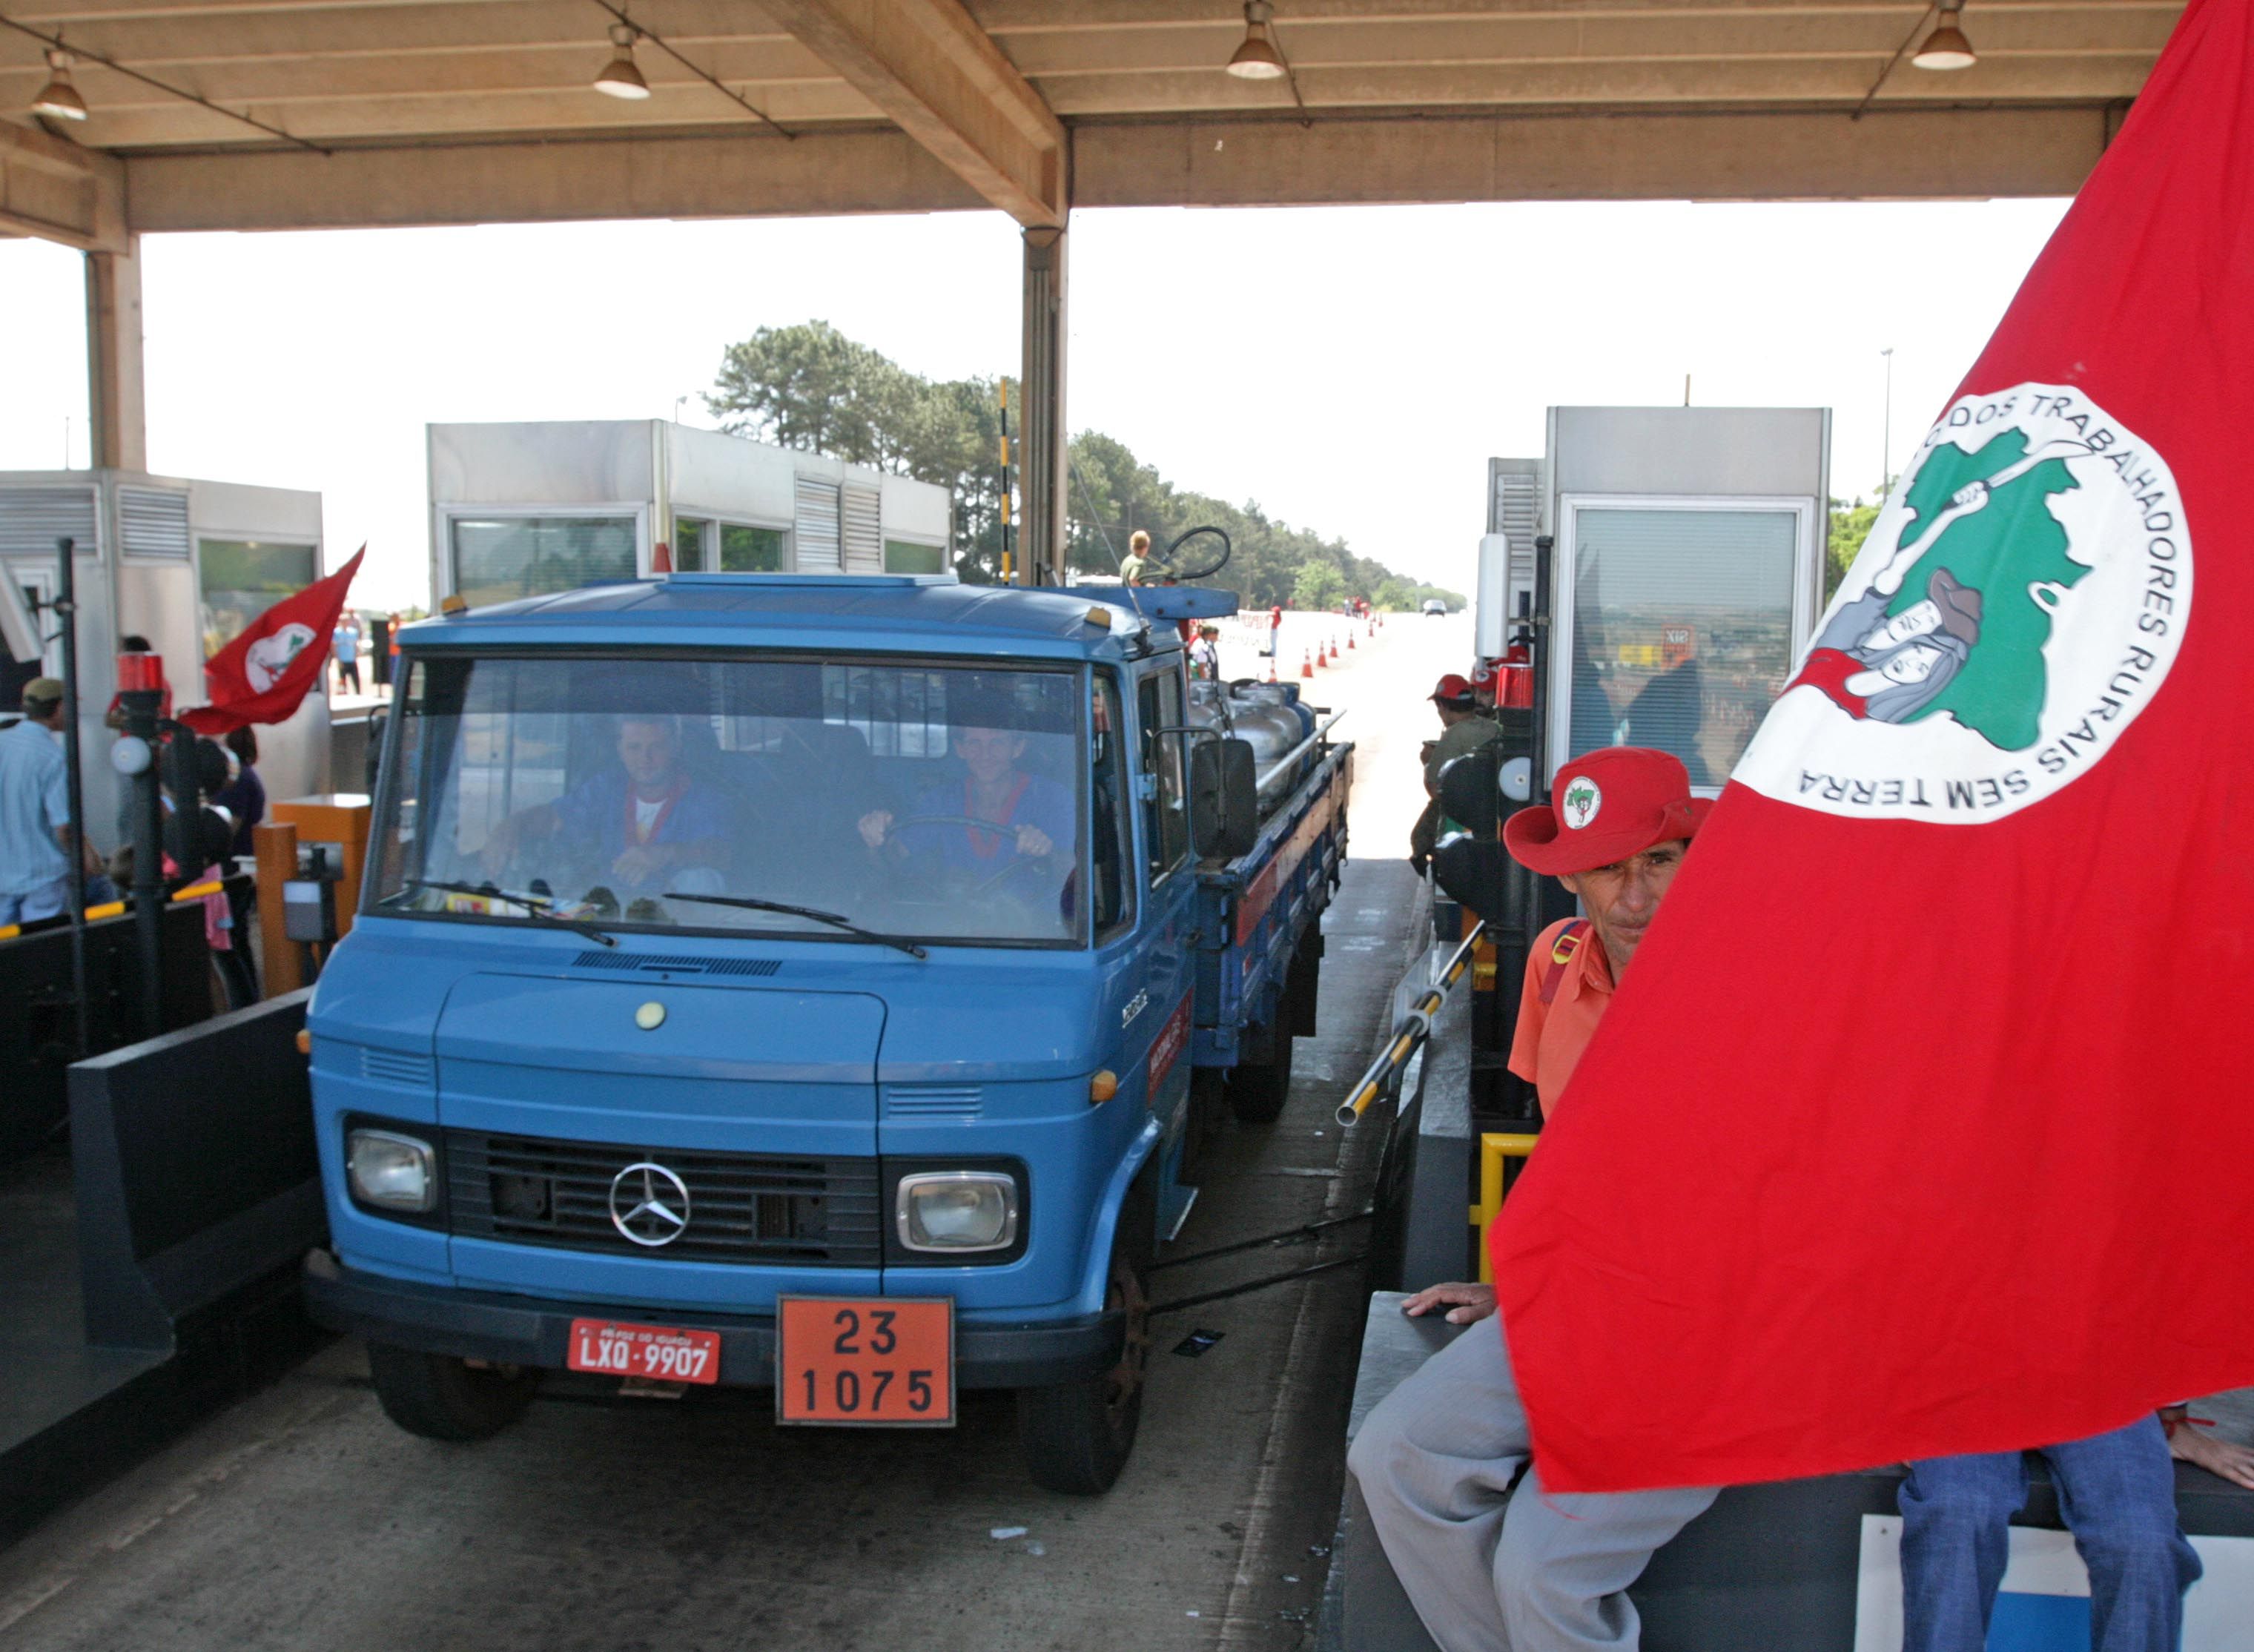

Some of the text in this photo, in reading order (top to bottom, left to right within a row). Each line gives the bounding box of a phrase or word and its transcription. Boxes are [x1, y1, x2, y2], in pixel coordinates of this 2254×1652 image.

[1797, 394, 2177, 809] DOS TRABALHADORES RURAIS SEM TERRA
[833, 1309, 896, 1355] 23
[802, 1369, 933, 1413] 1075
